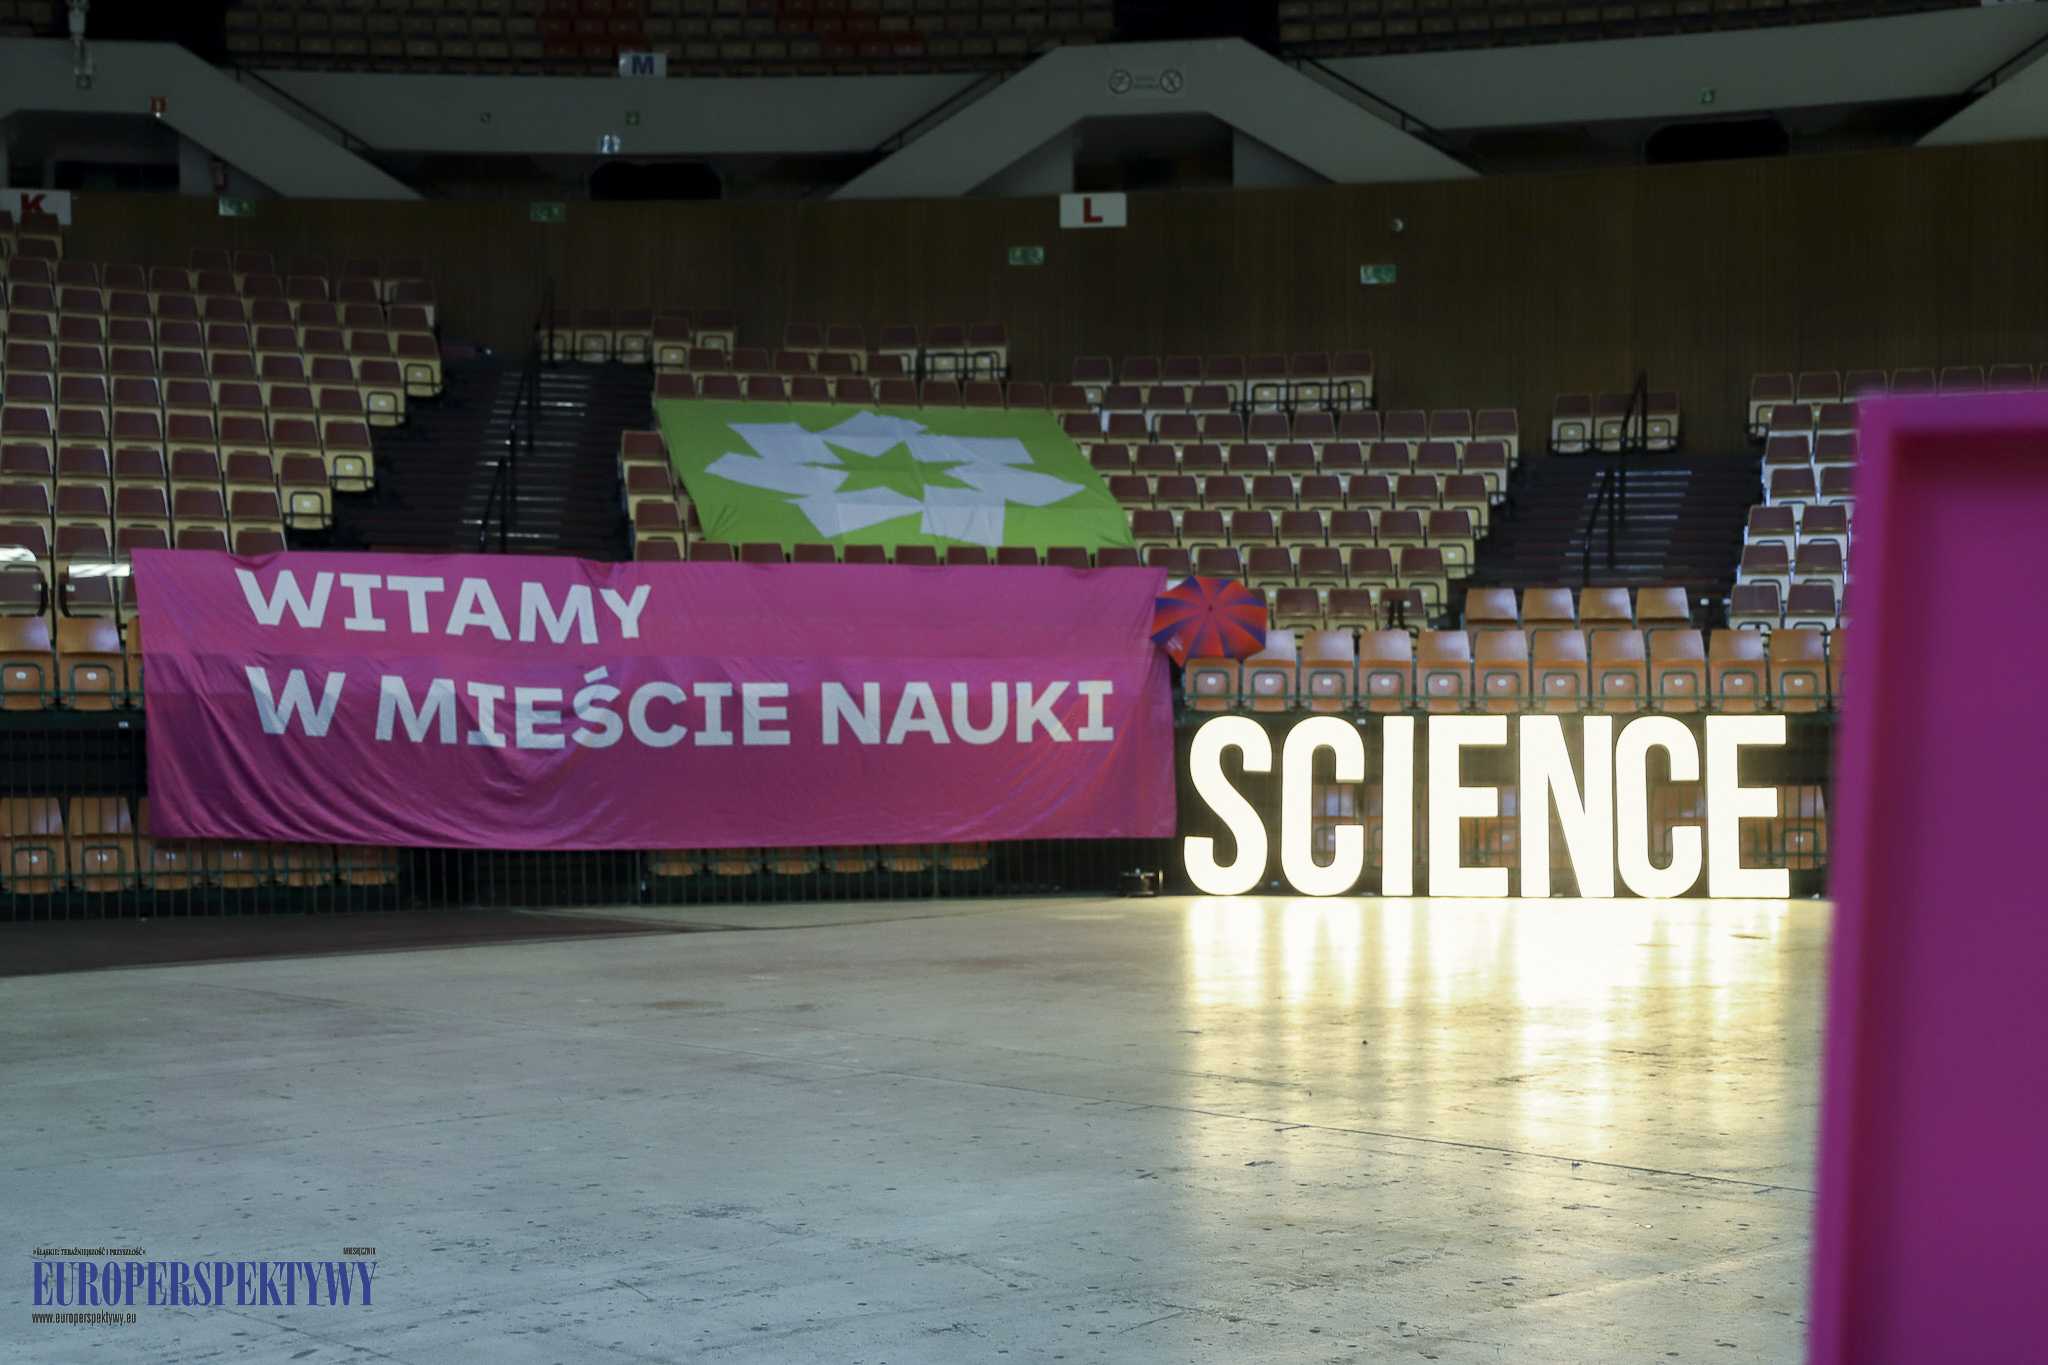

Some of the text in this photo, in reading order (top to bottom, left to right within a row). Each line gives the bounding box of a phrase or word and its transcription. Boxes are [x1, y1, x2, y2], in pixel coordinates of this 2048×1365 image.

[632, 55, 655, 75] M
[1083, 197, 1103, 223] L
[235, 567, 651, 644] WITAMY
[244, 666, 1114, 749] W MIEŚCIE NAUKI
[1183, 715, 1790, 898] SCIENCE
